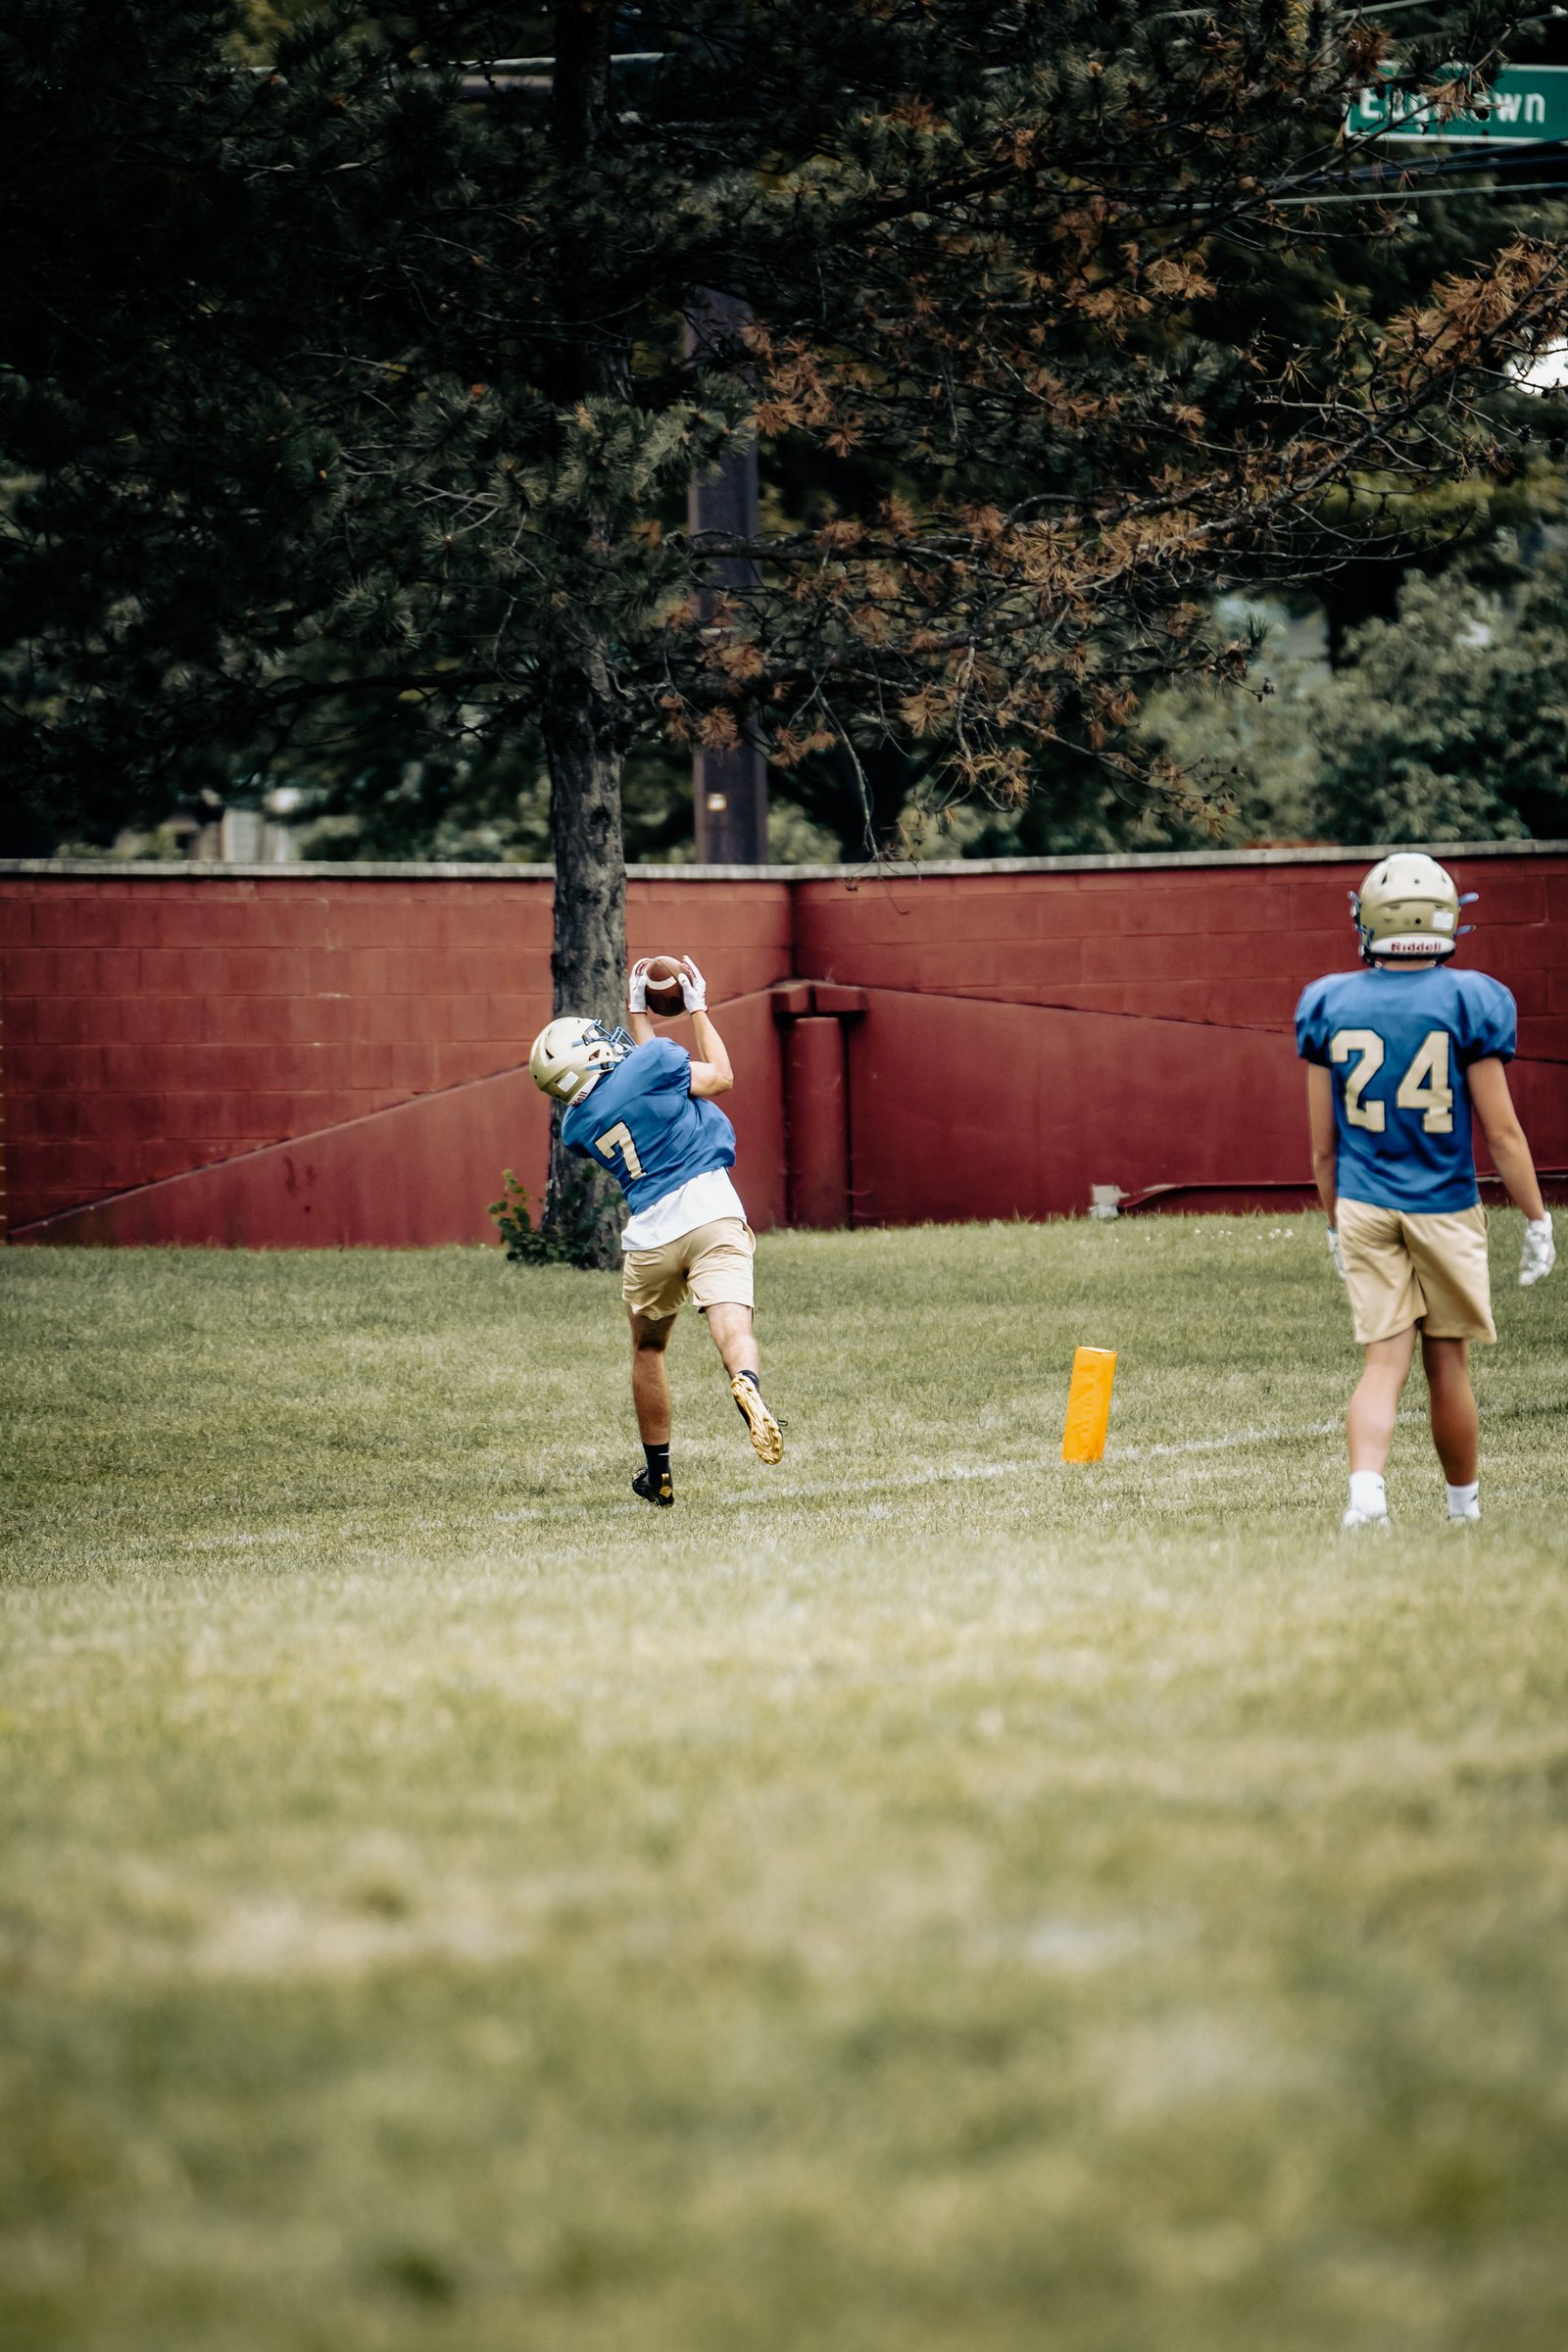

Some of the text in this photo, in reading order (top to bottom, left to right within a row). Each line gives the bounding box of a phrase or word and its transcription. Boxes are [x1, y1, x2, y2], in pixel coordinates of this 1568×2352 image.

[1391, 941, 1442, 953] Riddell
[1330, 1029, 1453, 1133] 24
[594, 1120, 647, 1181] 7
